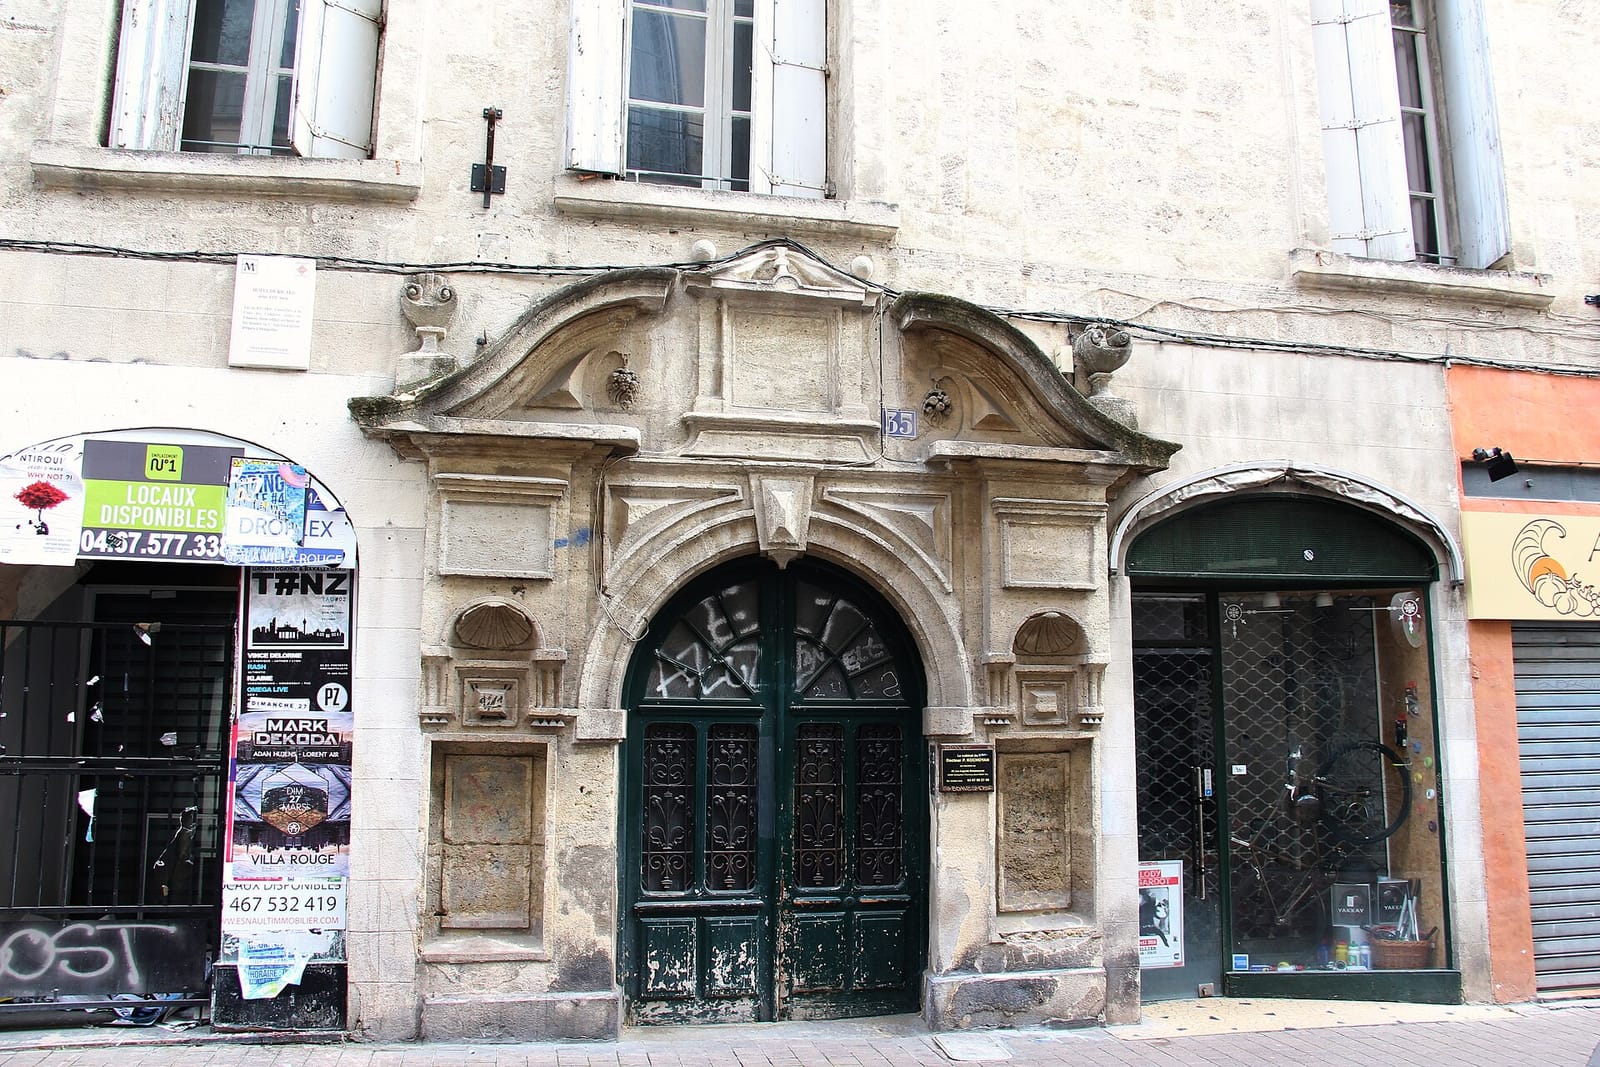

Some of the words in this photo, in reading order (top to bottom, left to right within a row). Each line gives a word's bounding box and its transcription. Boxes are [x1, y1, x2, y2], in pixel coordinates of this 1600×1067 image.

[887, 411, 913, 435] 35
[150, 458, 177, 472] N°1
[127, 485, 197, 507] LOCAUX
[101, 504, 218, 529] DISPONIBLES
[252, 572, 347, 595] T#NZ
[325, 688, 340, 705] PZ
[267, 719, 326, 732] MARK
[256, 733, 338, 745] DEKODA
[286, 787, 303, 795] DIM
[283, 803, 307, 811] MARS
[251, 854, 285, 865] VILLA
[290, 854, 335, 865] ROUGE
[230, 896, 262, 912] 467
[268, 897, 299, 912] 532
[304, 896, 337, 912] 419
[250, 969, 278, 978] HORAIRE
